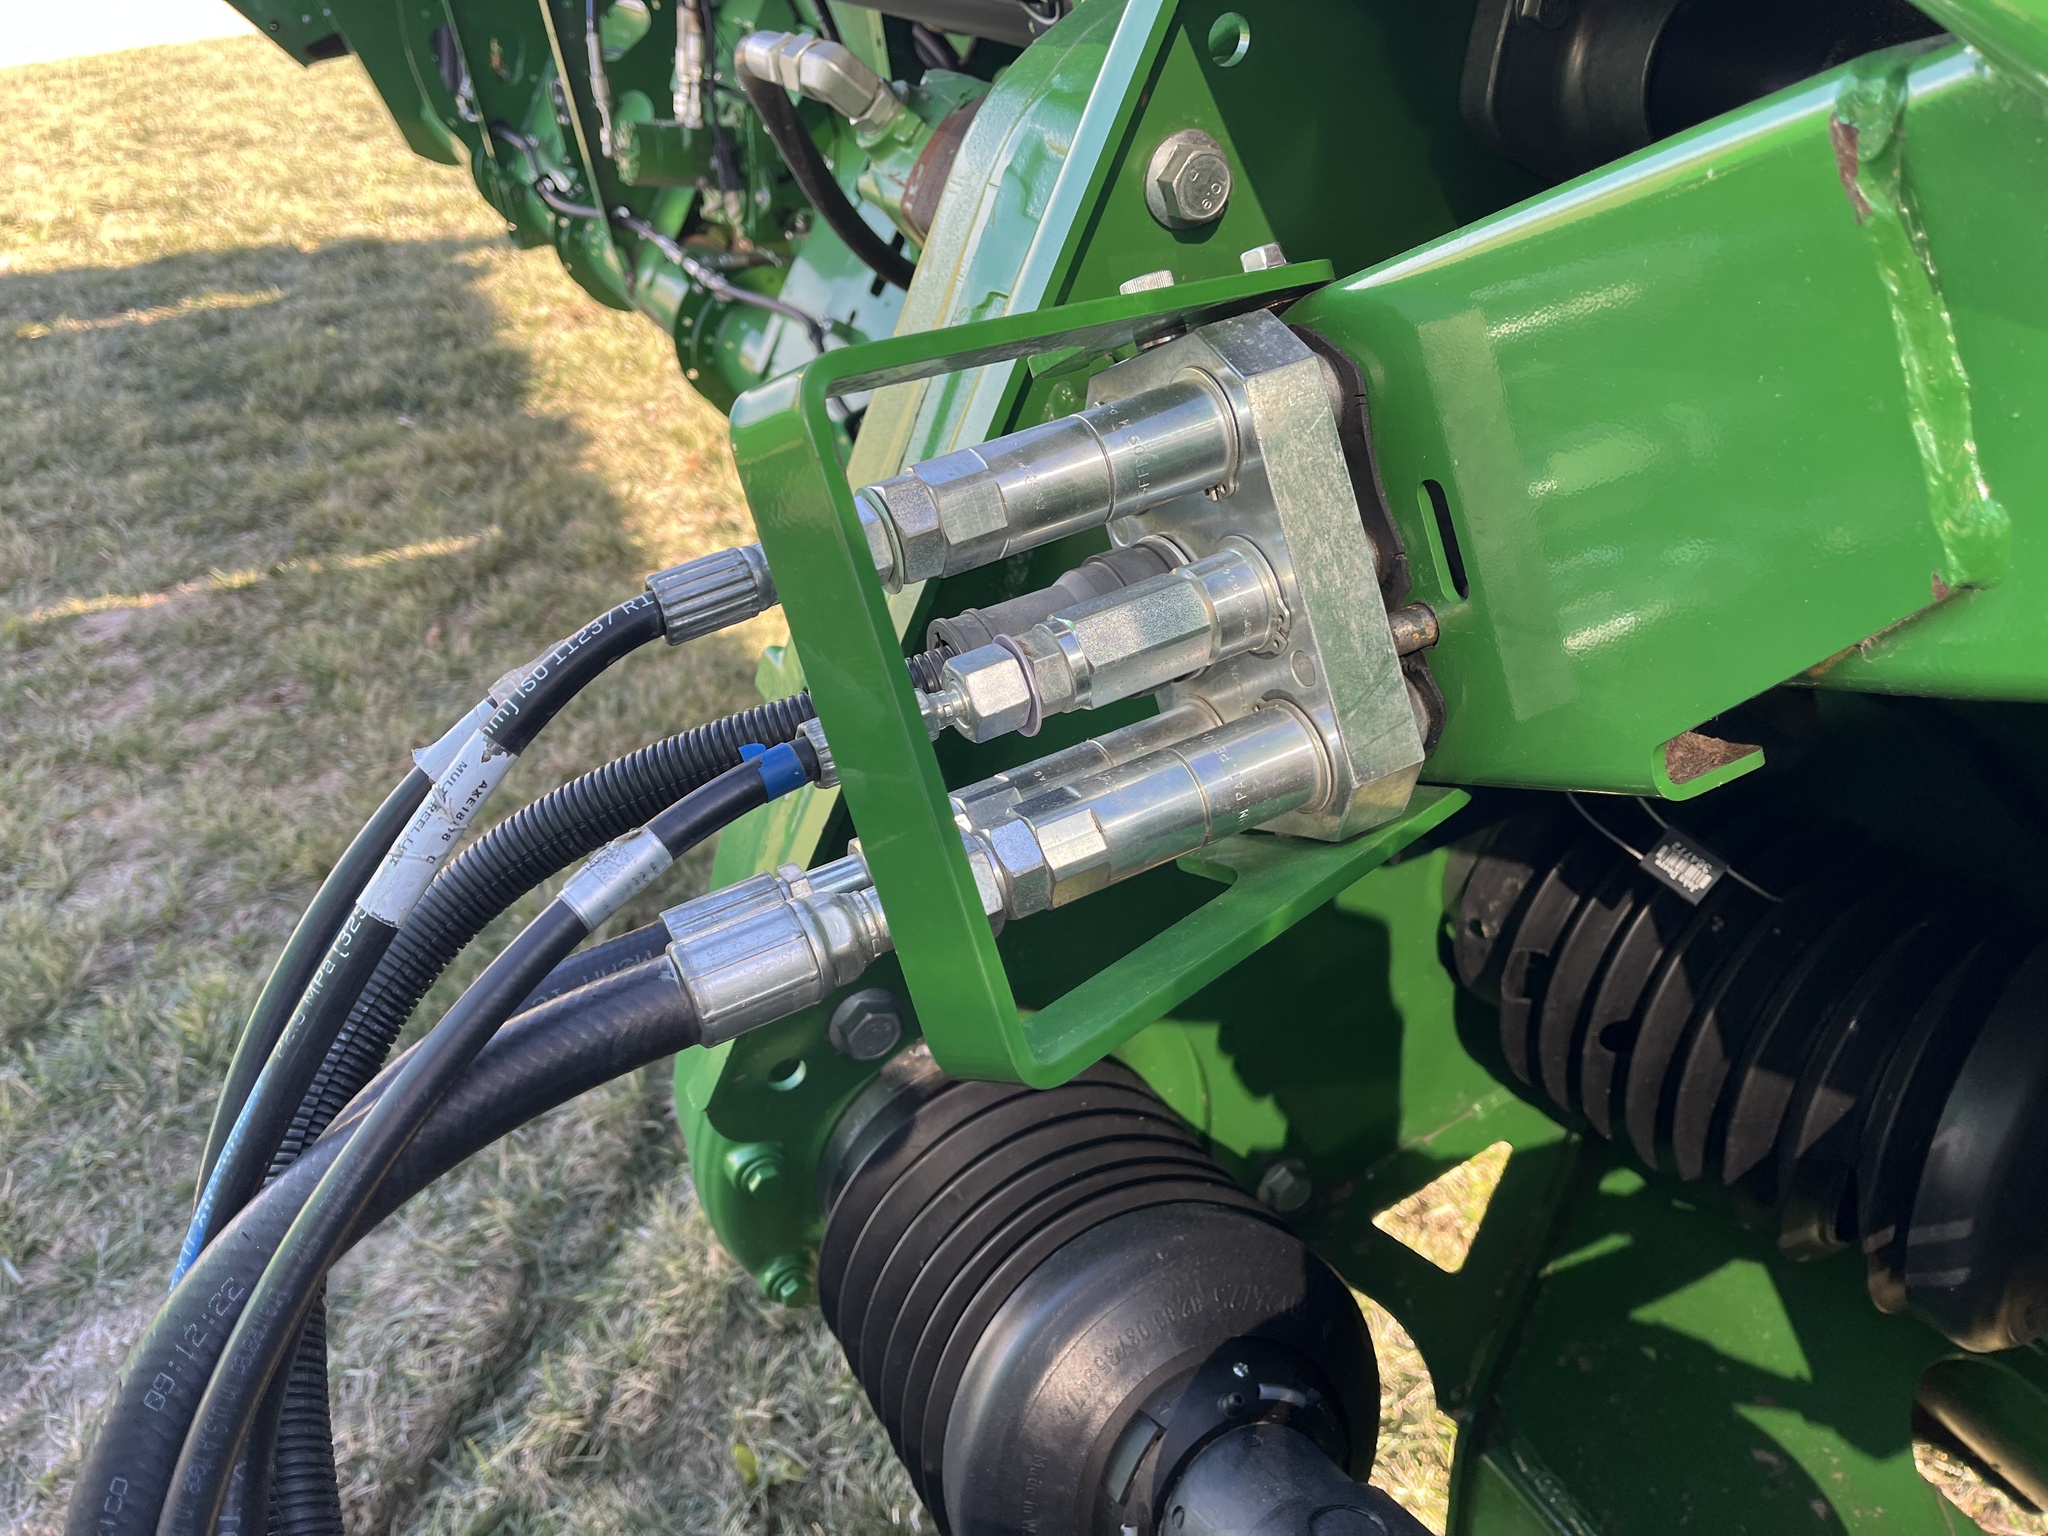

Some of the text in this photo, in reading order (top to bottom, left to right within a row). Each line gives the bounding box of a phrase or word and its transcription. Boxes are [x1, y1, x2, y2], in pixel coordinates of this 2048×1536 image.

[304, 959, 336, 1007] MPa
[514, 664, 549, 699] ISO
[552, 612, 614, 666] 11237
